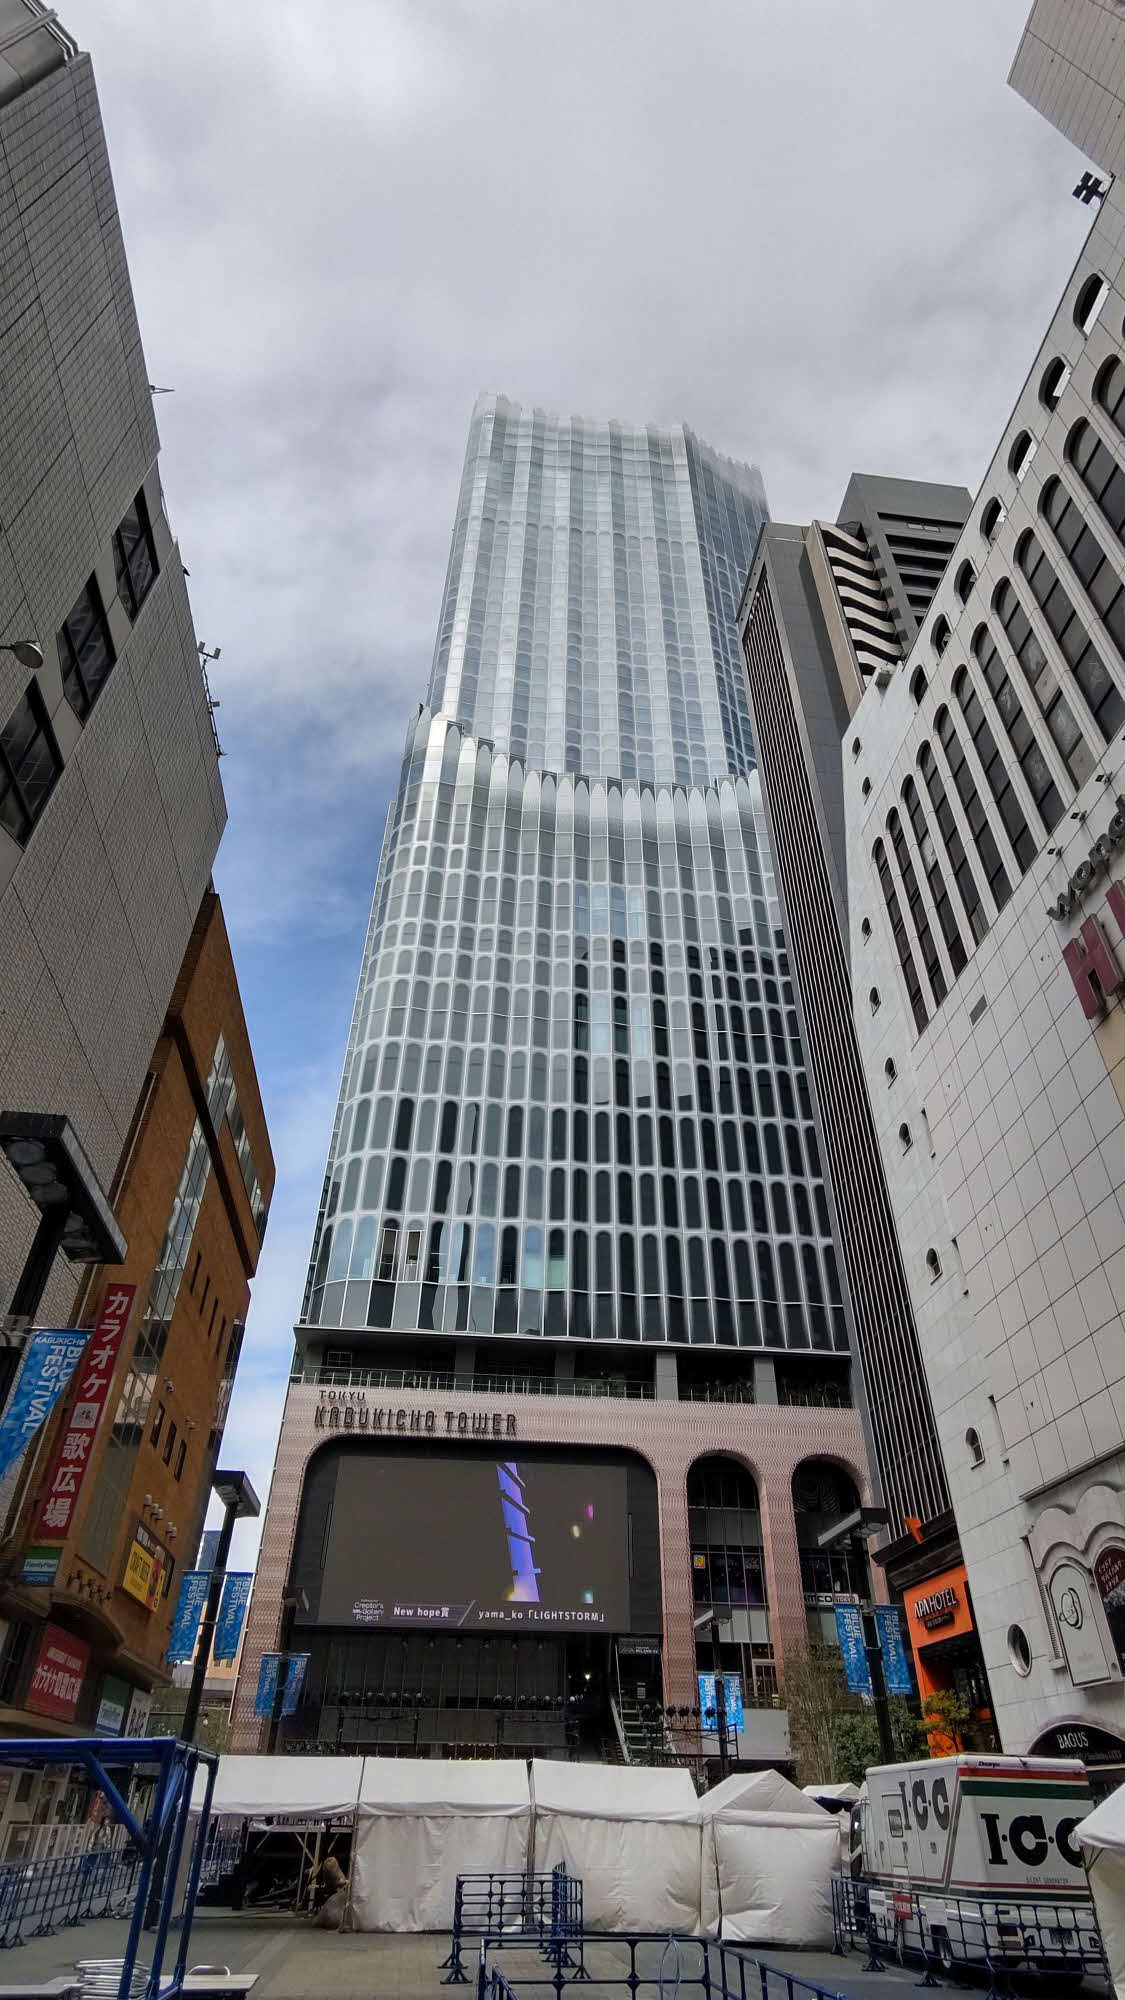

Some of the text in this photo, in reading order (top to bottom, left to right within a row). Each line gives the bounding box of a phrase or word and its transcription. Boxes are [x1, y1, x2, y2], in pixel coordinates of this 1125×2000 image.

[82, 1291, 129, 1399] カラオケ
[21, 1344, 68, 1434] FESTIVAL
[318, 1390, 366, 1401] TOKYU
[314, 1405, 517, 1434] KABUKICHO TOWER
[42, 1432, 90, 1528] 歌広場
[180, 1580, 198, 1629] FESTIVAL
[194, 1579, 207, 1606] BLUE
[225, 1581, 242, 1629] FESTIVAL
[238, 1580, 251, 1605] BLUE
[915, 1587, 957, 1619] APA HOTEL
[356, 1613, 379, 1623] Project
[393, 1606, 413, 1616] New
[478, 1609, 523, 1621] yama_ko
[842, 1613, 858, 1660] FESTIVAL
[850, 1612, 862, 1639] BLUE
[883, 1614, 898, 1664] FESTIVAL
[890, 1614, 901, 1641] BLUE
[1056, 1731, 1089, 1749] BAGUS
